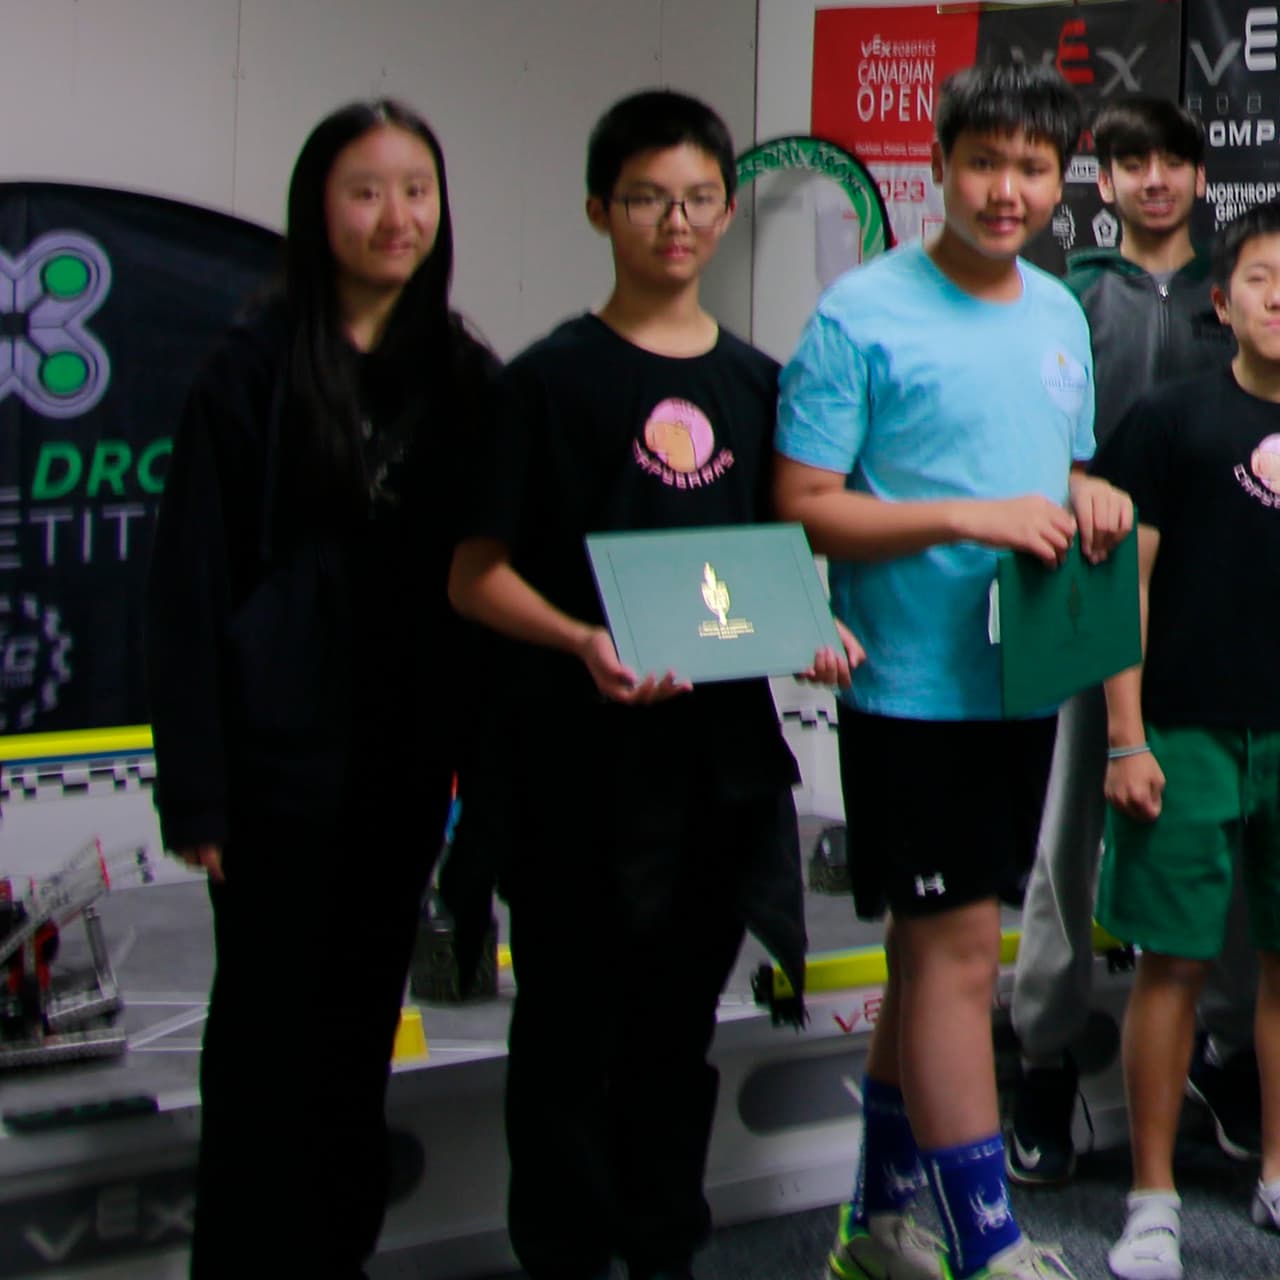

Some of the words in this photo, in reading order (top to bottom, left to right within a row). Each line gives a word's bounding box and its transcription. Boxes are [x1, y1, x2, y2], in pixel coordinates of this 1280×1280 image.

[860, 34, 891, 58] VEX
[892, 39, 936, 57] ROBOTICS
[857, 58, 935, 86] CANADIAN
[857, 84, 934, 122] OPEN
[879, 179, 925, 203] 023
[1205, 182, 1277, 204] NORTHROP
[832, 992, 884, 1033] VE
